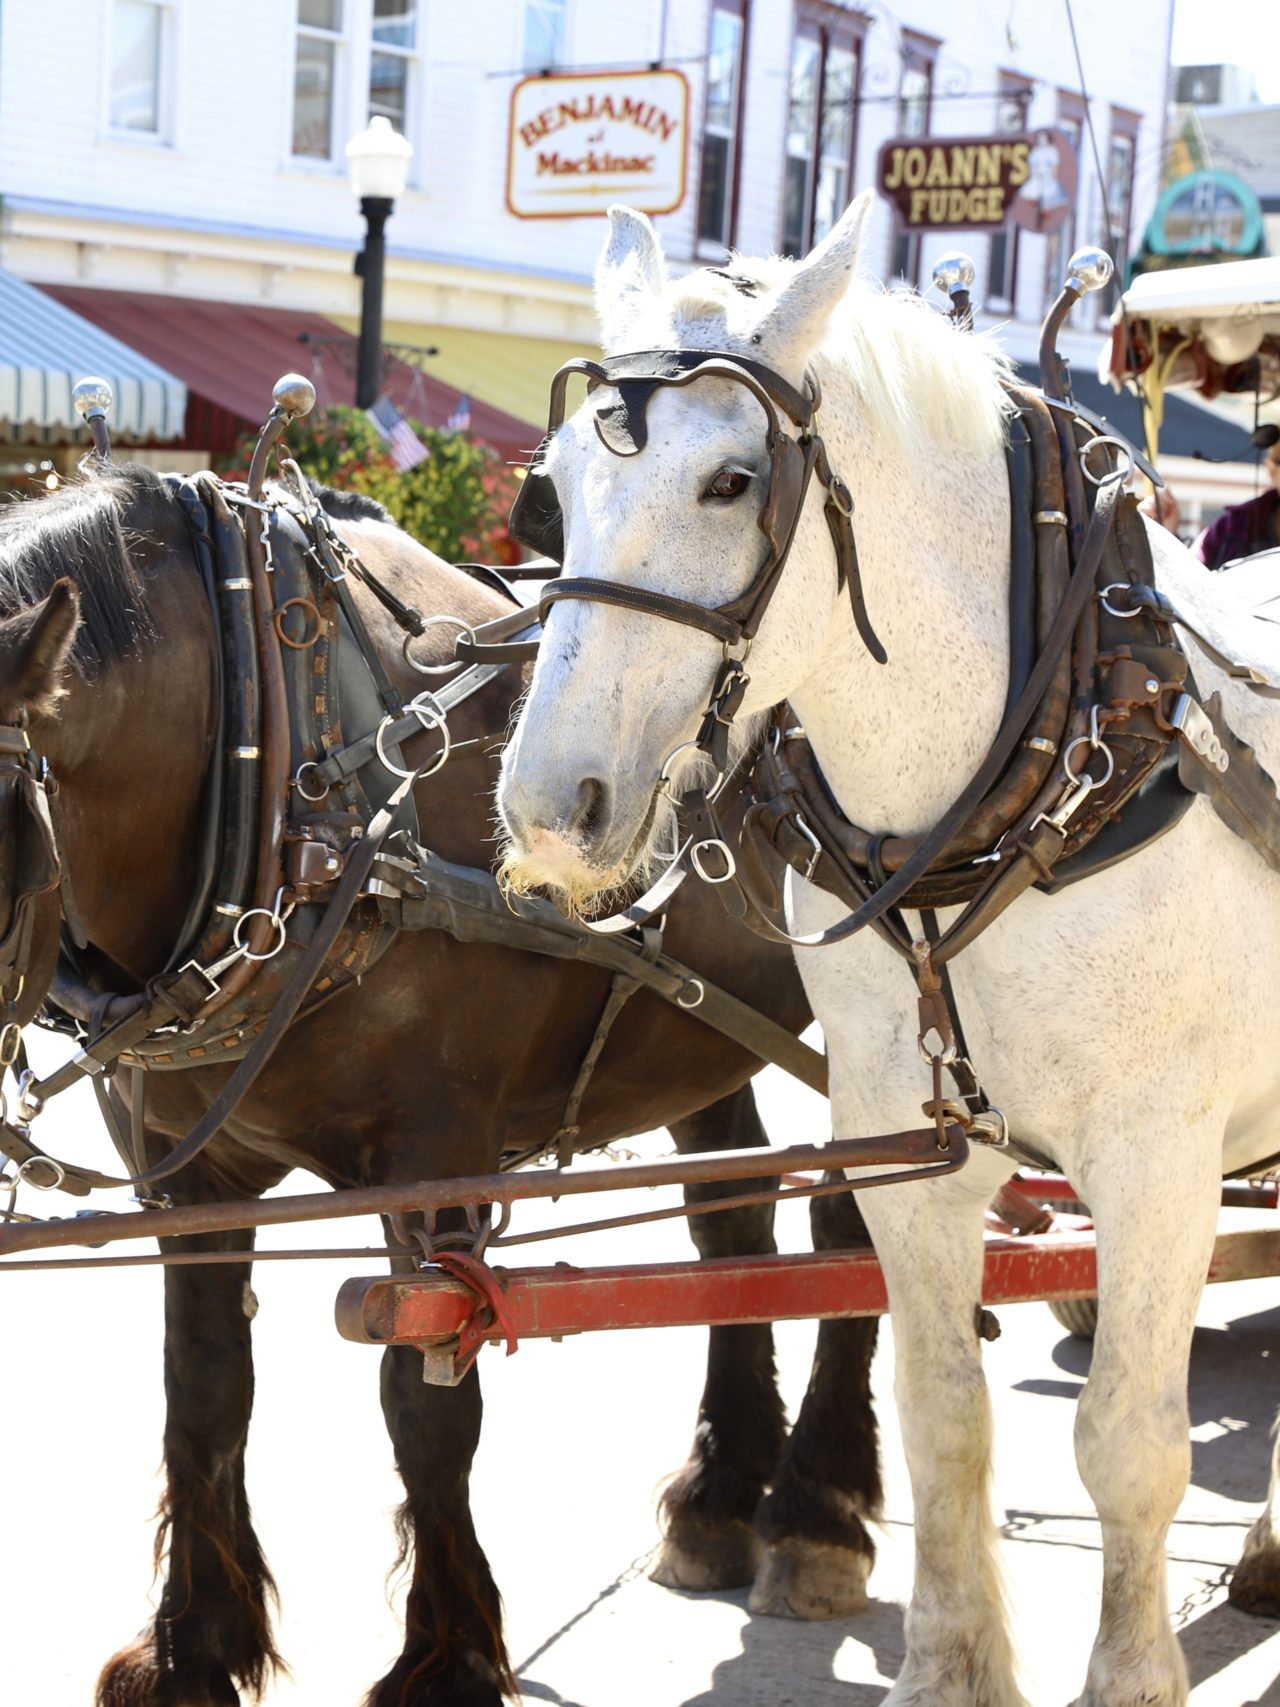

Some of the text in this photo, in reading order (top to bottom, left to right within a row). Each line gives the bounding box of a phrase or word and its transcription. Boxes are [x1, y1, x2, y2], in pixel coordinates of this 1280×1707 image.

[520, 94, 677, 147] BENJAMIN
[536, 151, 655, 177] Mackinac
[884, 142, 1029, 189] JOANN'S
[908, 187, 1005, 224] FUDGE
